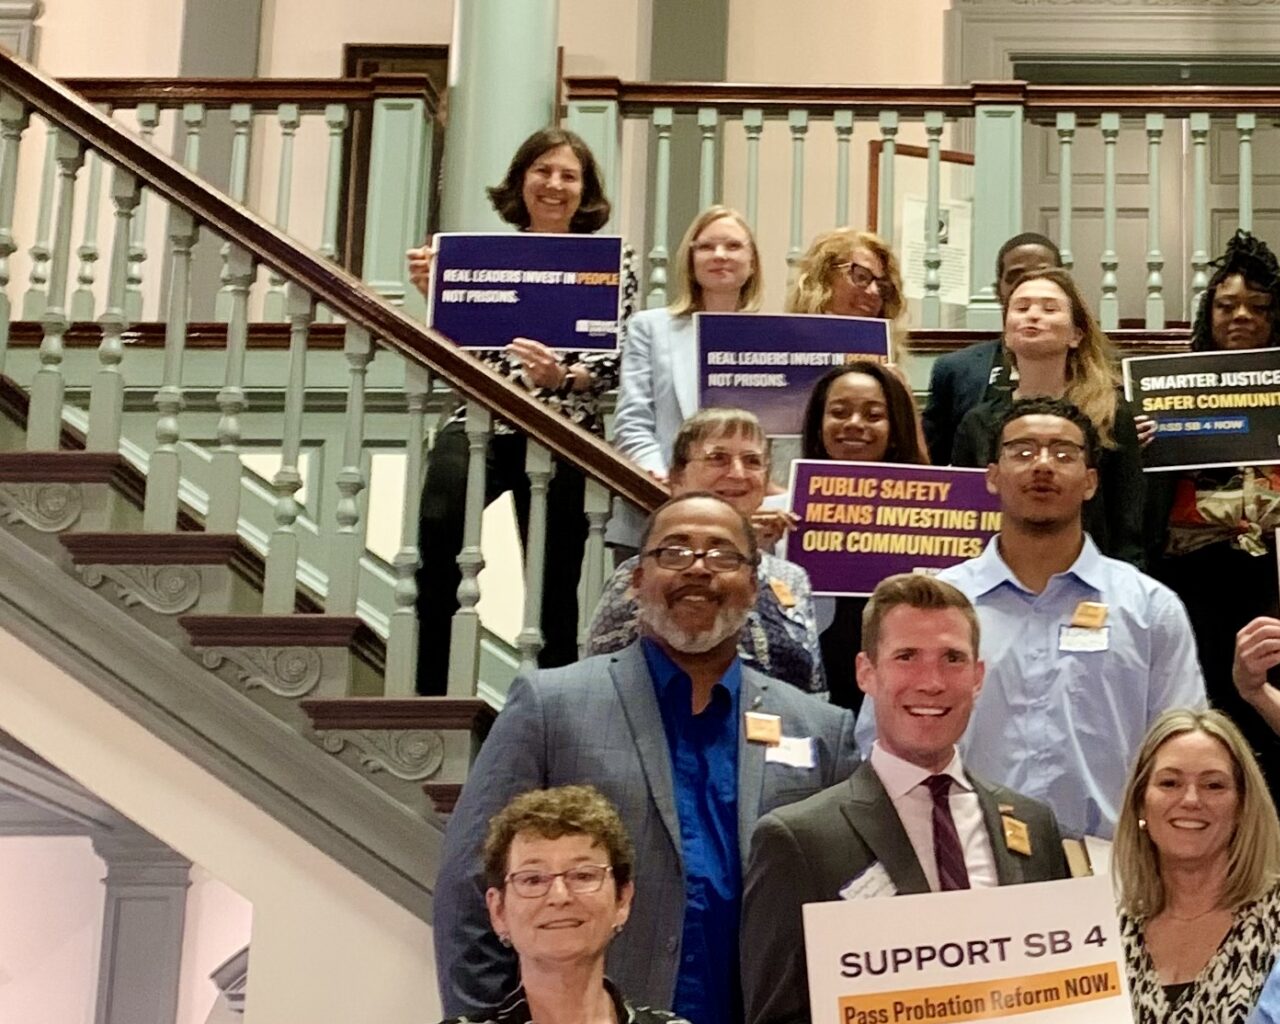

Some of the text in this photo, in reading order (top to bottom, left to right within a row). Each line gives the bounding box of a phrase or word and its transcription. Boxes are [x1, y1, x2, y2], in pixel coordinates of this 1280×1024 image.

[443, 269, 470, 282] REAL
[472, 270, 522, 284] LEADERS
[523, 270, 562, 284] INVEST
[563, 272, 576, 284] IN
[442, 290, 520, 303] NOT PRISONS.
[708, 352, 738, 365] REAL
[738, 352, 788, 366] LEADERS
[790, 352, 830, 366] INVEST
[832, 352, 844, 366] IN
[708, 374, 789, 386] NOT PRISONS.
[1140, 374, 1220, 391] SMARTER
[1142, 395, 1195, 412] SAFER
[1158, 420, 1244, 432] ASS SB 4 NOW
[809, 476, 952, 502] PUBLIC SAFETY
[805, 503, 1002, 532] MEANS INVESTING IN
[803, 530, 984, 558] OUR COMMUNITIES
[840, 926, 1108, 978] SUPPORT SB 4
[894, 996, 986, 1022] Probation
[990, 984, 1060, 1010] Reform
[1065, 972, 1116, 999] NOW.
